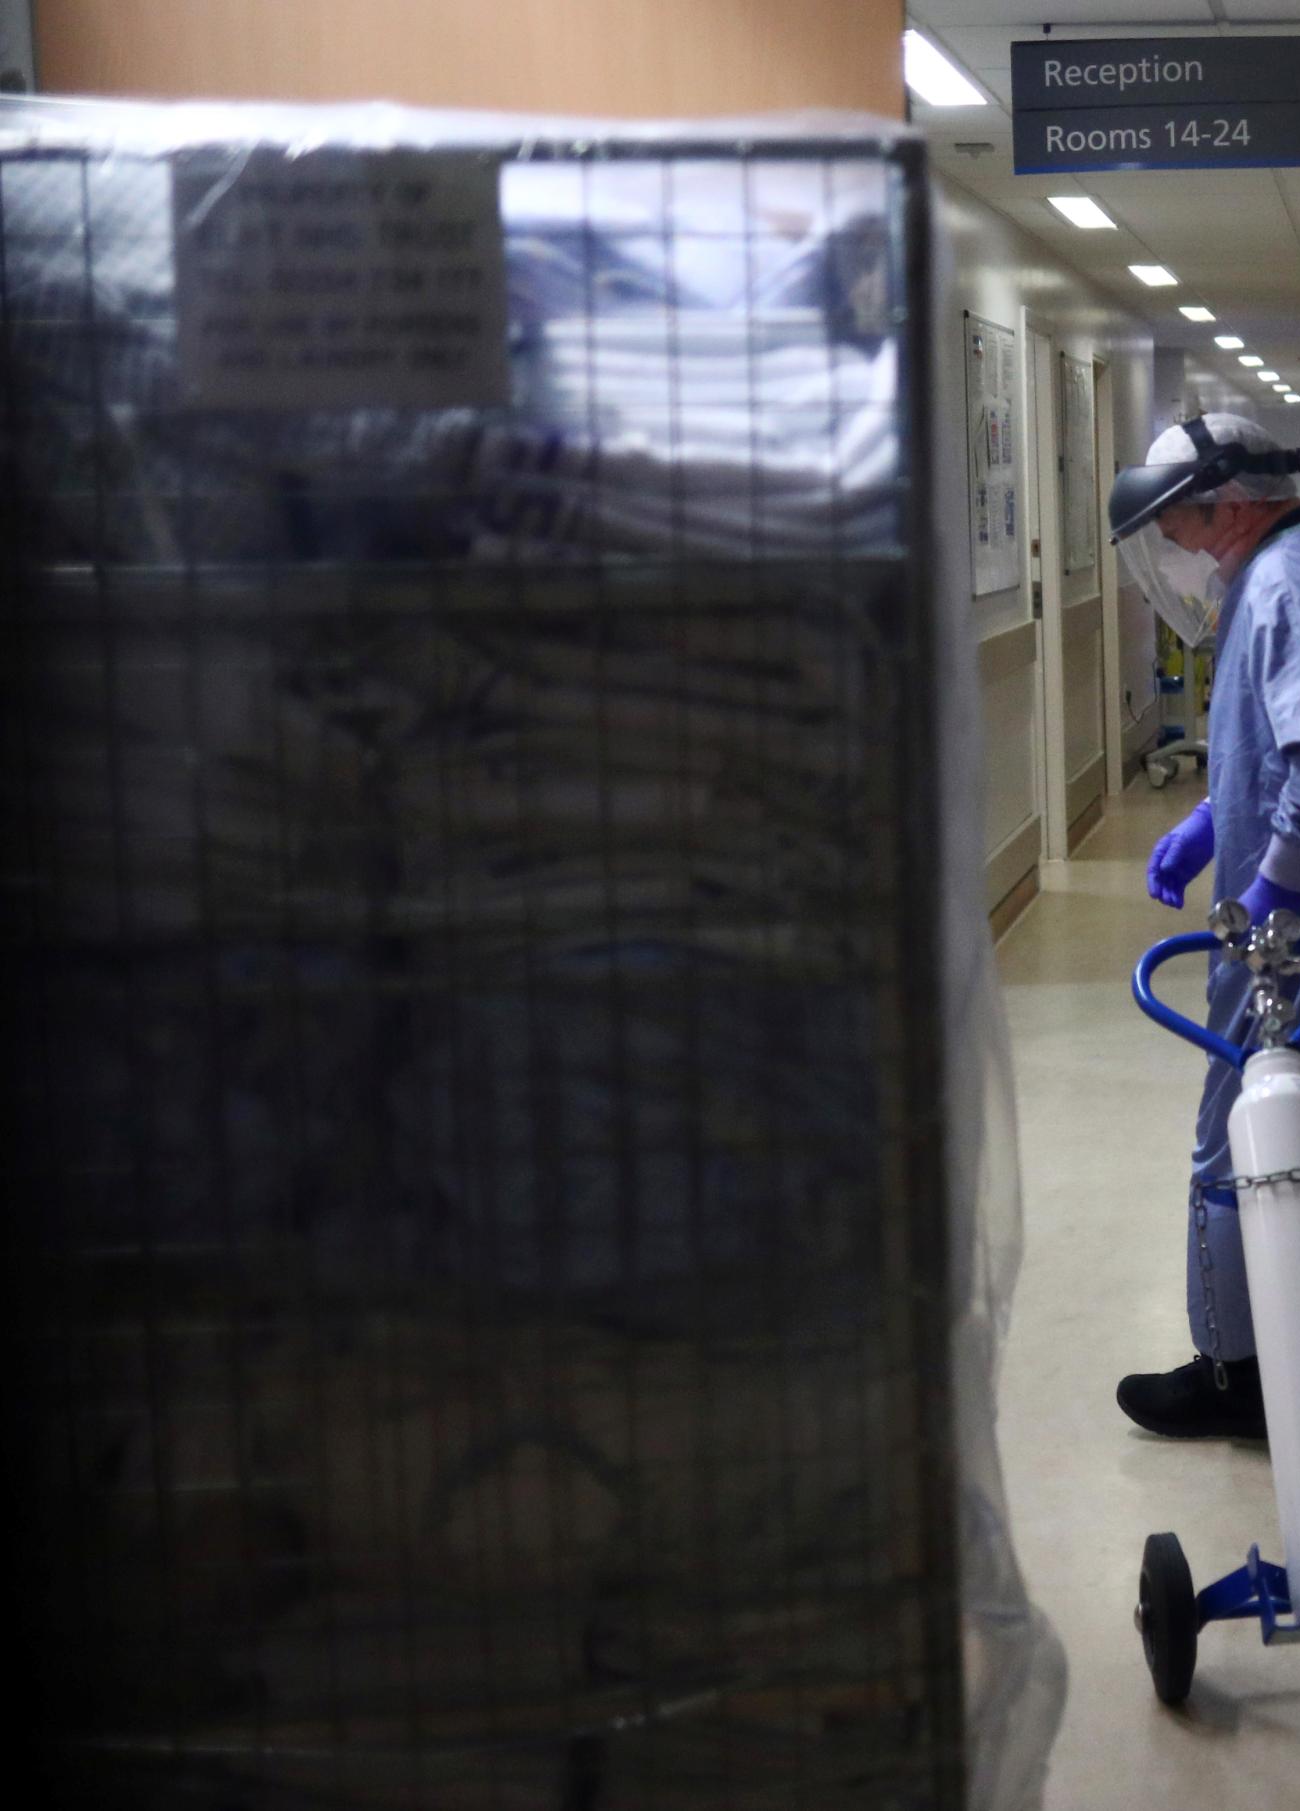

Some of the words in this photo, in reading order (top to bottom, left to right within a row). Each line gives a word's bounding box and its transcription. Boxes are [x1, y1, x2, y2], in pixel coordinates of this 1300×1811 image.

[1044, 54, 1204, 92] Reception
[1046, 126, 1151, 153] Rooms
[1164, 119, 1251, 148] 14-24
